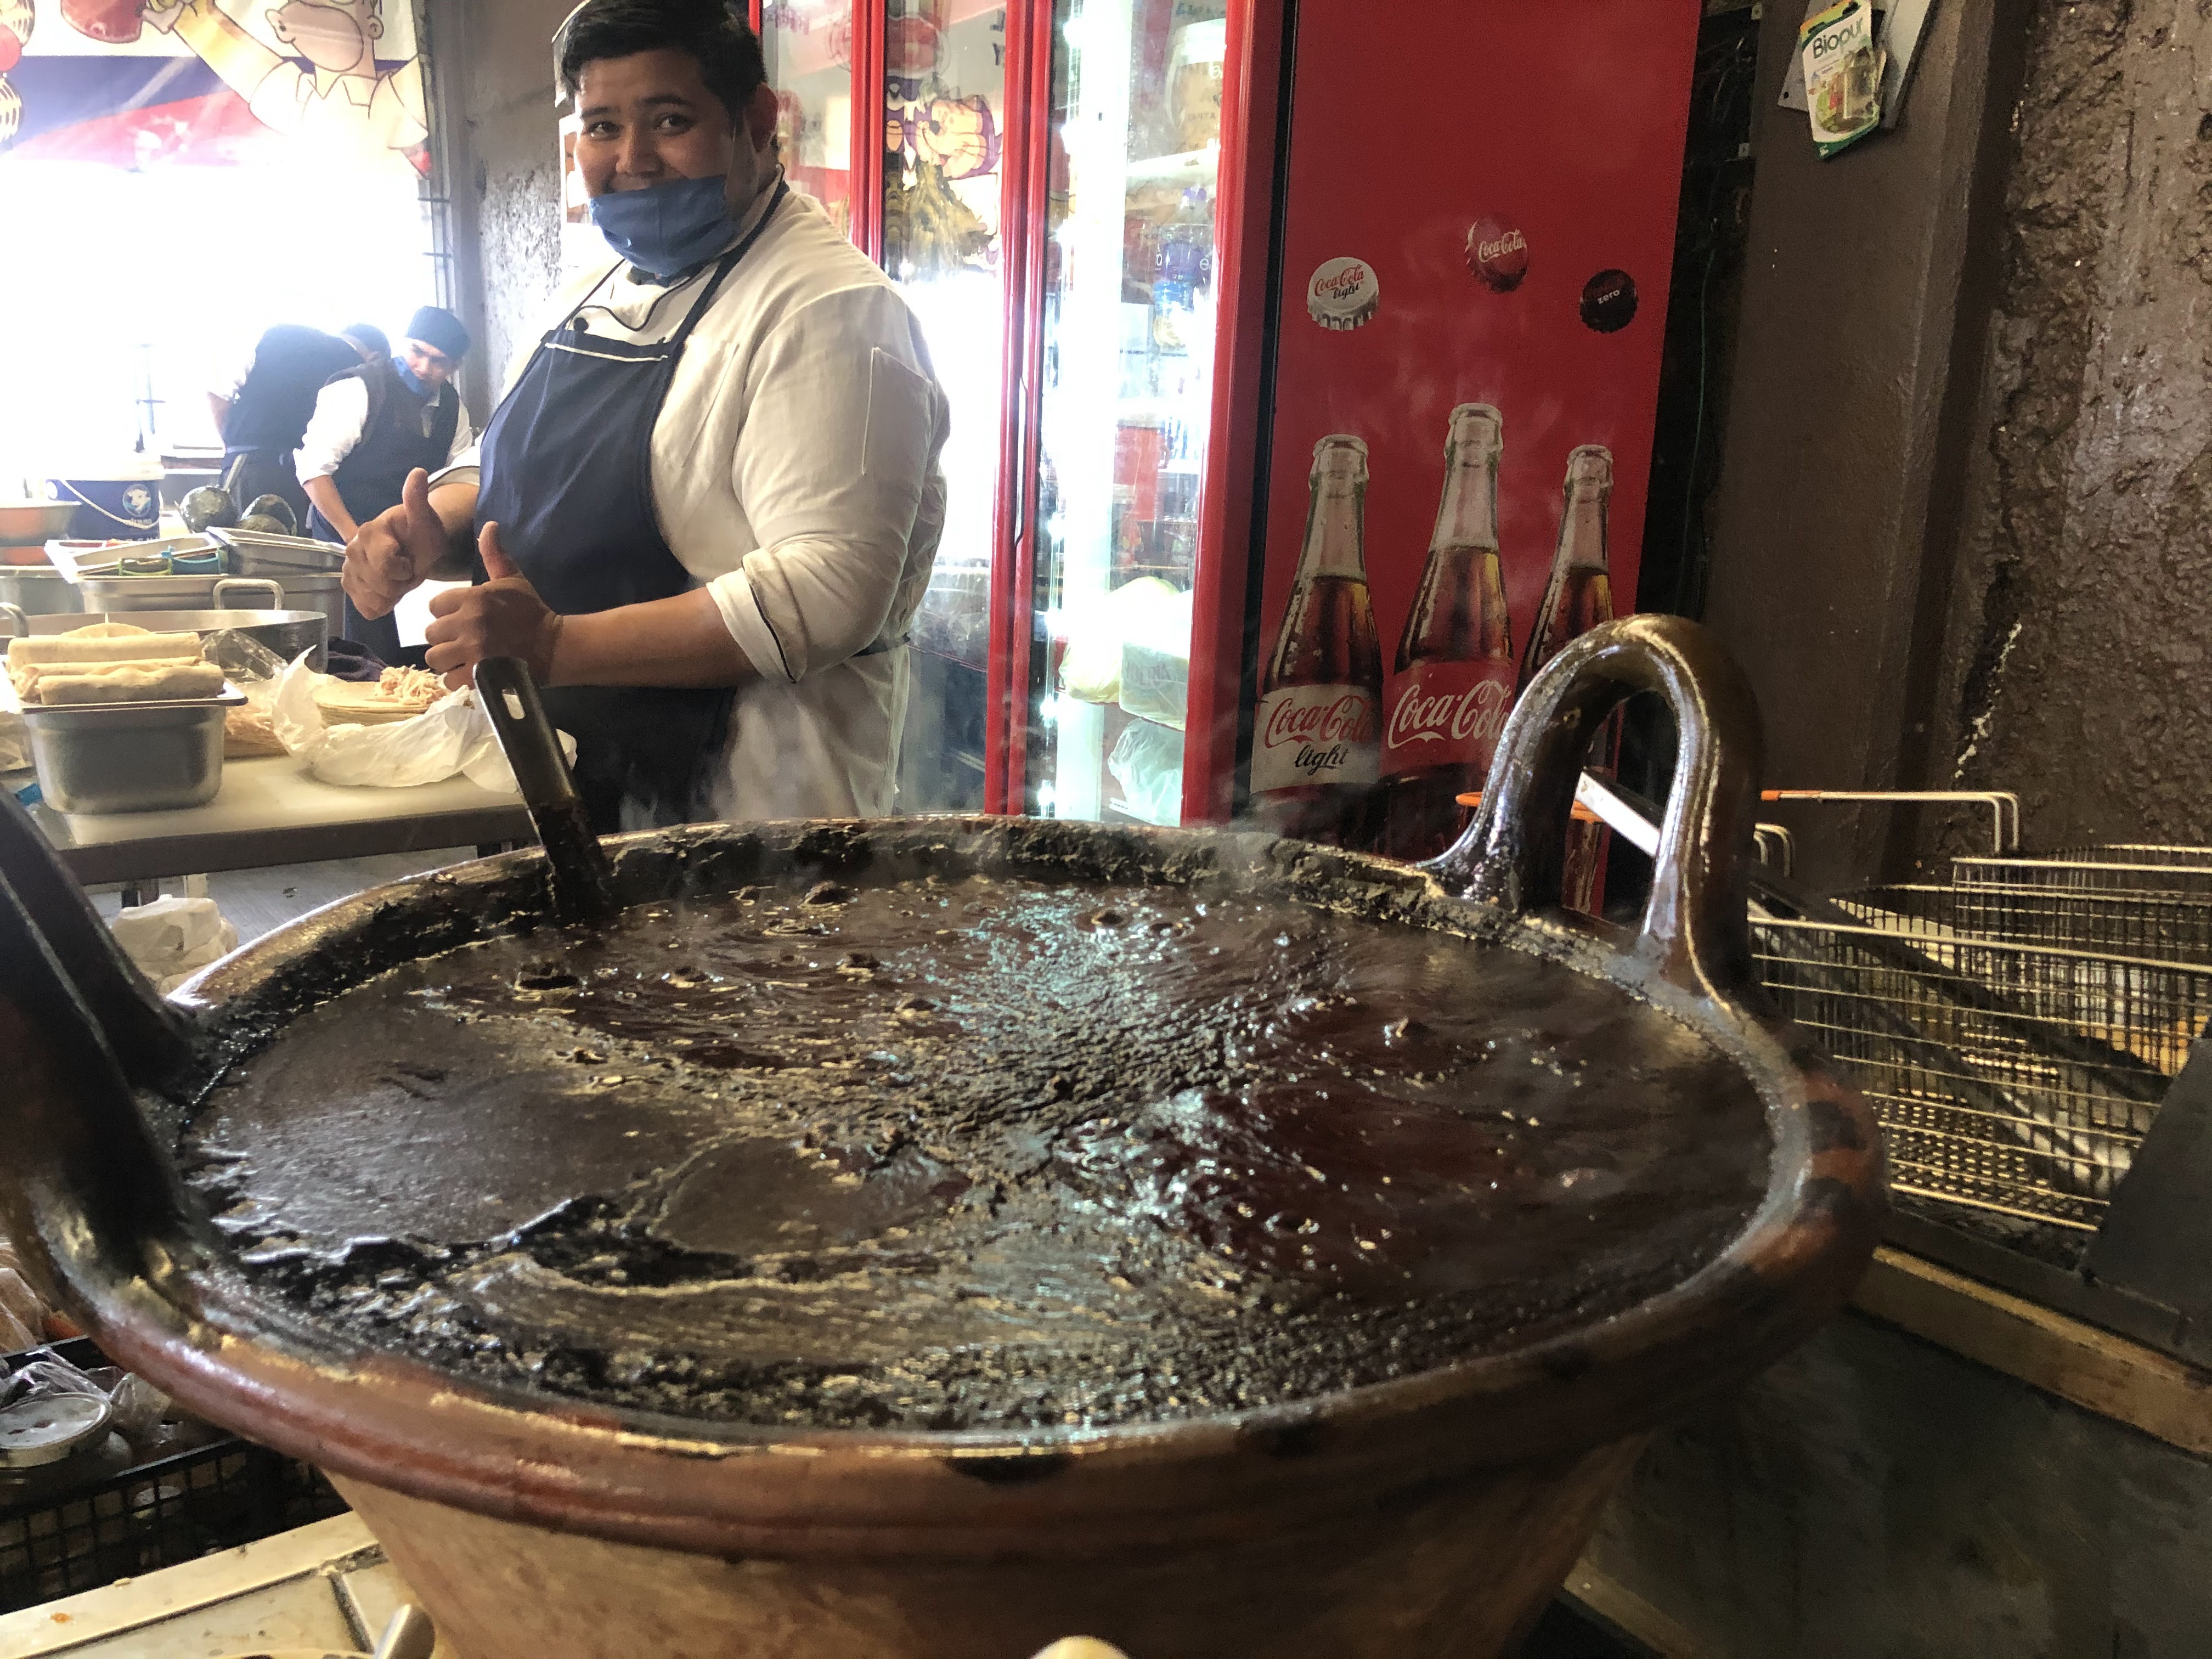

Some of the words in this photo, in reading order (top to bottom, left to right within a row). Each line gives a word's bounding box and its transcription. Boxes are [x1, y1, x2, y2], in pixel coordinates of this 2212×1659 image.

[1813, 18, 1863, 59] Biopur
[1333, 283, 1360, 300] light
[1597, 290, 1620, 304] zero
[1295, 743, 1348, 776] light
